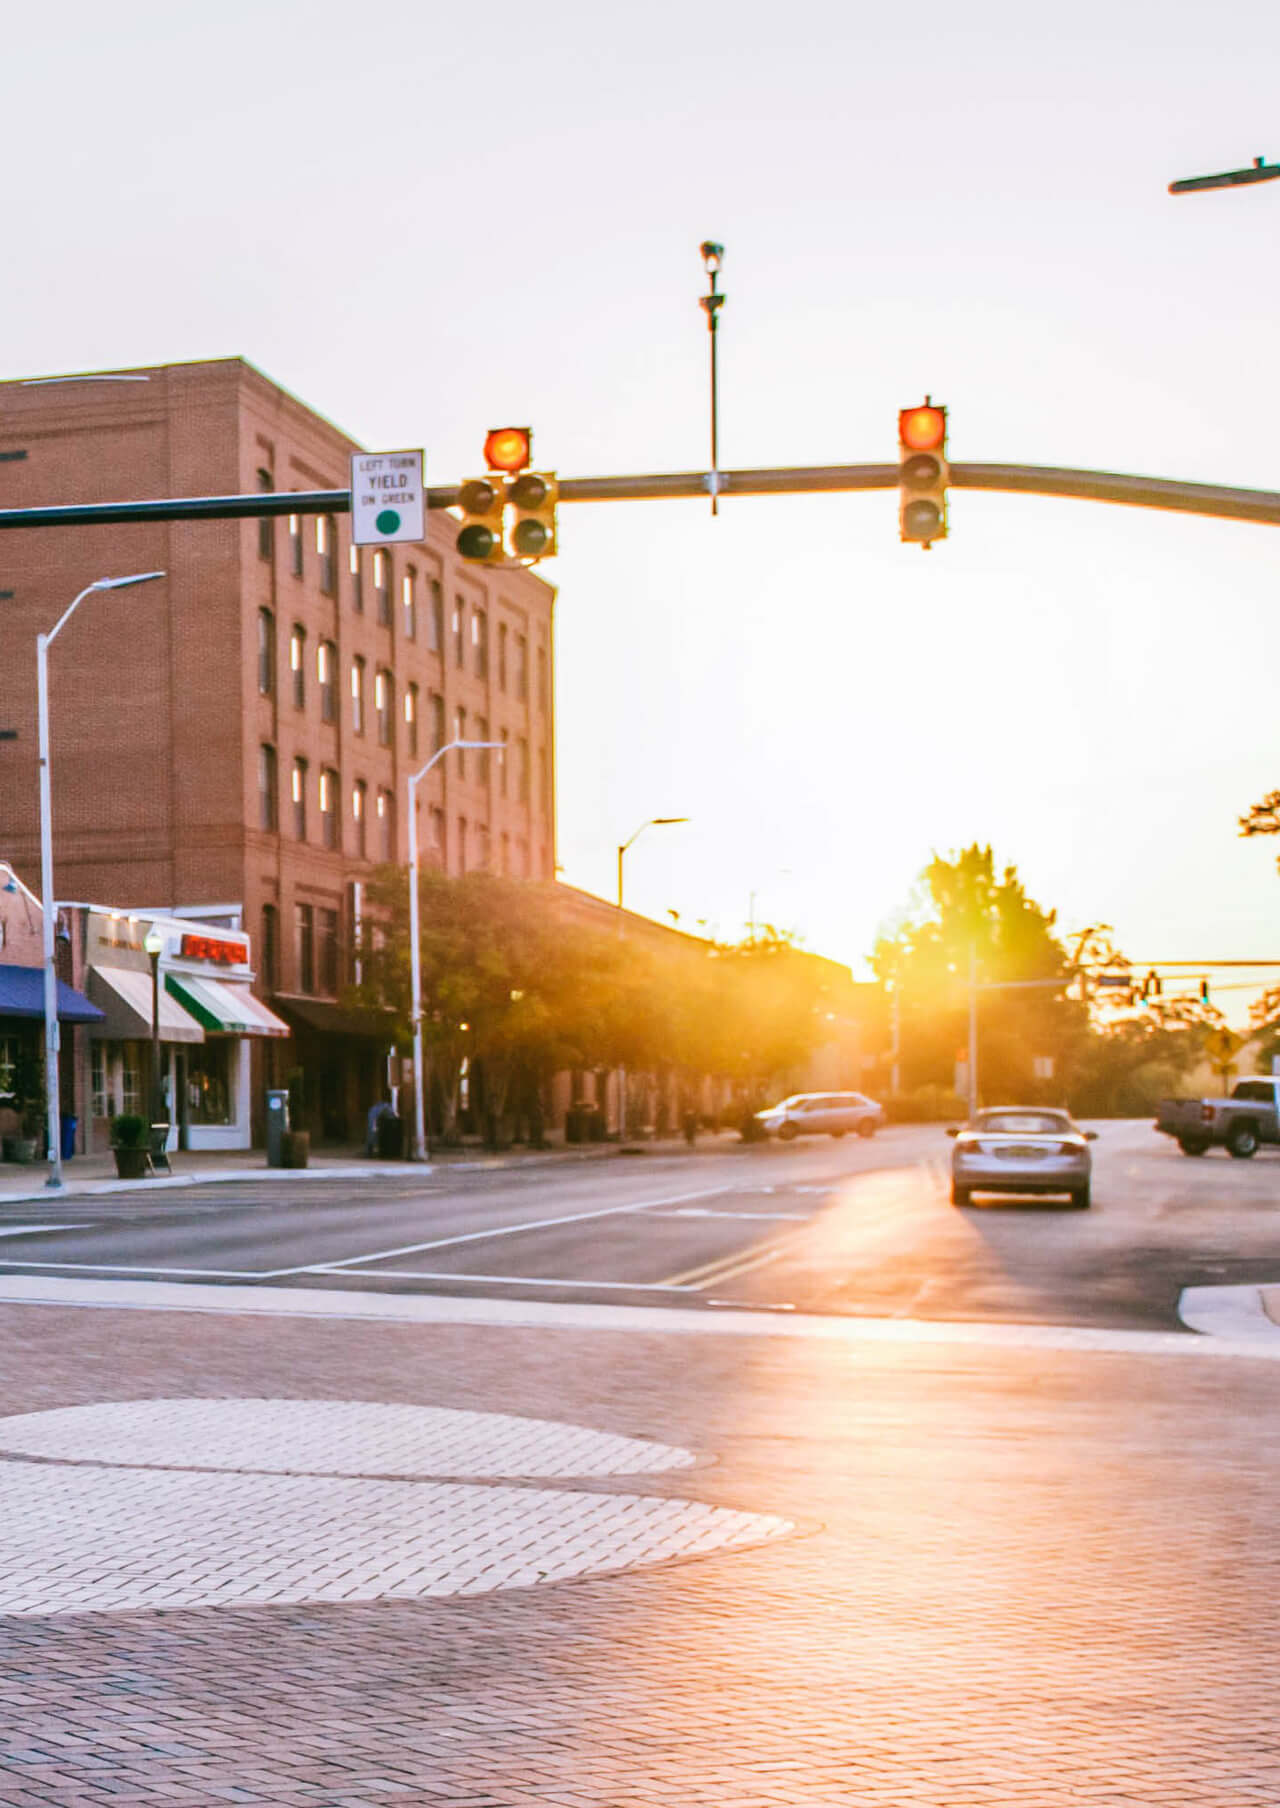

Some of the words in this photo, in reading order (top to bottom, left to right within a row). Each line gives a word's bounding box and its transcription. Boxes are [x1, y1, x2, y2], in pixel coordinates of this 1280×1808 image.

[359, 460, 383, 471] LEFT
[369, 473, 408, 489] YIELD
[361, 496, 376, 507] ON
[382, 492, 415, 505] GREEN
